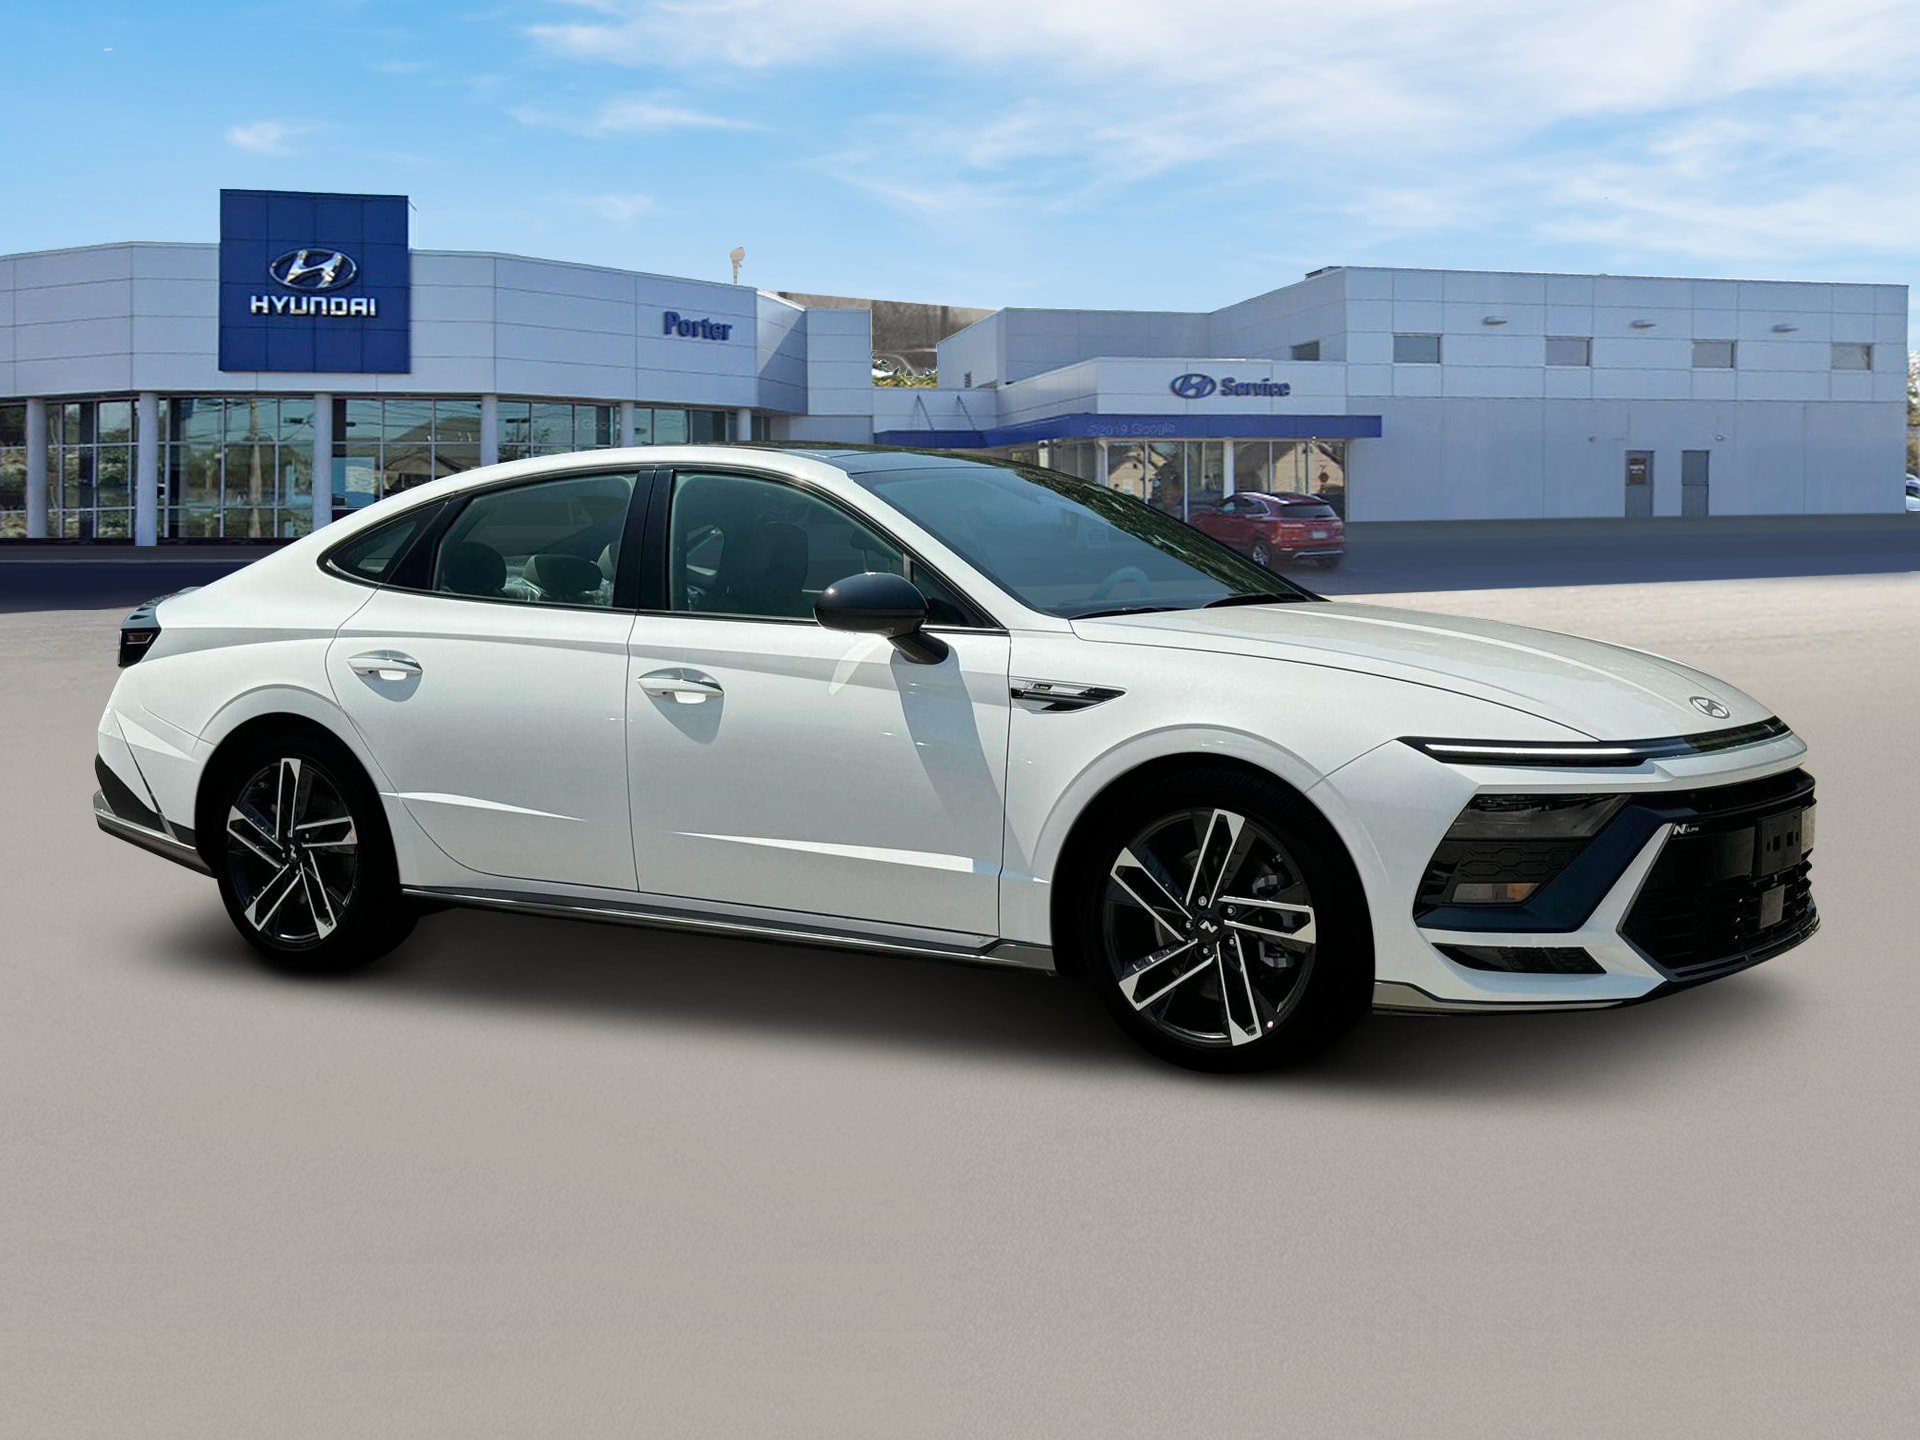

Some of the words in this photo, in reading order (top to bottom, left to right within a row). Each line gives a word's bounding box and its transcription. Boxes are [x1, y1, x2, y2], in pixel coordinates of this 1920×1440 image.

[250, 295, 376, 316] HYUNDAI
[663, 311, 732, 340] Porter
[1221, 377, 1291, 396] Service
